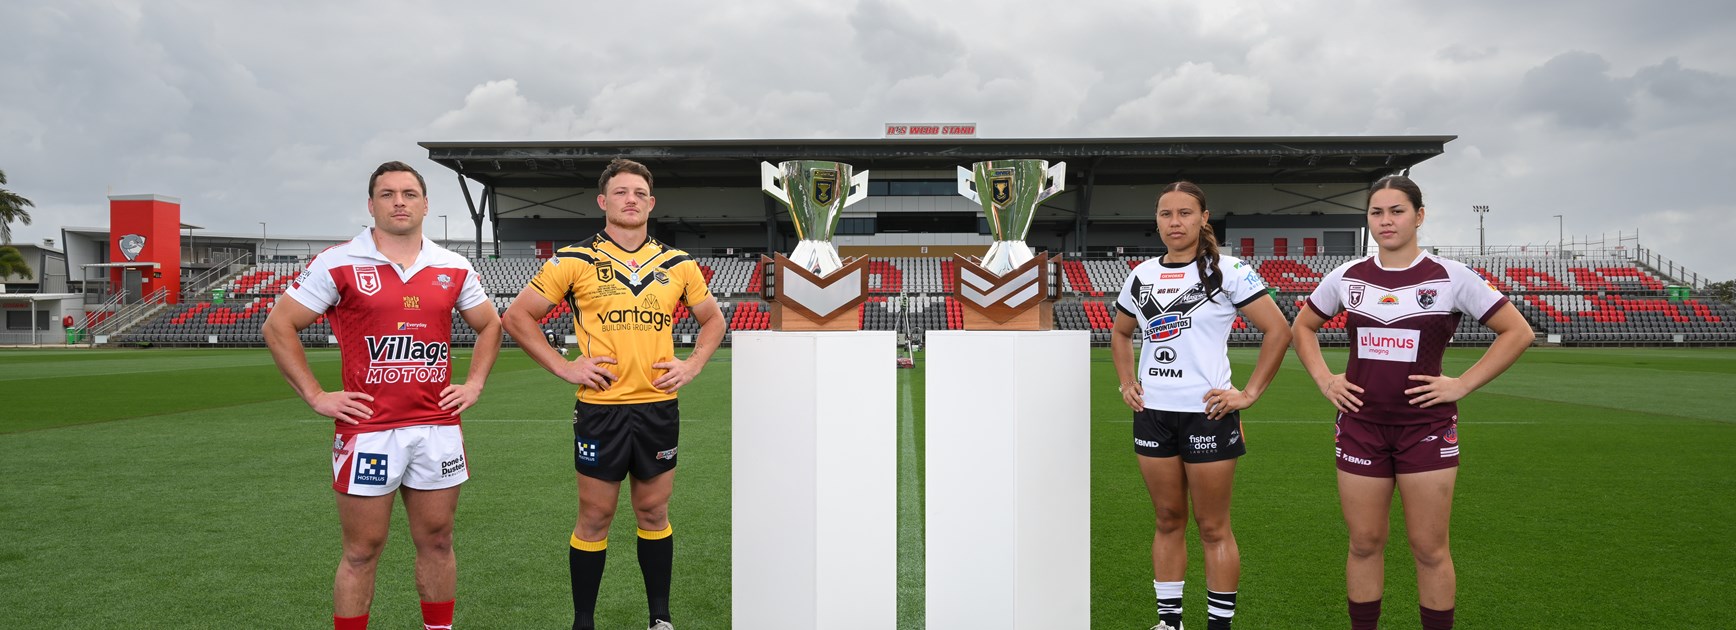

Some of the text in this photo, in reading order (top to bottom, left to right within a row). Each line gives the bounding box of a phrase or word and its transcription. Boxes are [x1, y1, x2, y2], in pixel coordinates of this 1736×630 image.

[909, 126, 939, 135] WEBB
[942, 126, 975, 135] STAND
[597, 306, 671, 332] vantage
[602, 323, 631, 333] BUILDING
[1368, 332, 1414, 349] lumus
[365, 335, 448, 366] Village
[366, 367, 447, 383] MOTORS
[1148, 367, 1183, 378] GWM
[1139, 439, 1159, 448] BMD
[1189, 434, 1216, 443] fisher
[1194, 442, 1217, 450] dore
[441, 458, 459, 468] Done
[1348, 455, 1372, 465] BMD
[441, 461, 465, 476] Dusted
